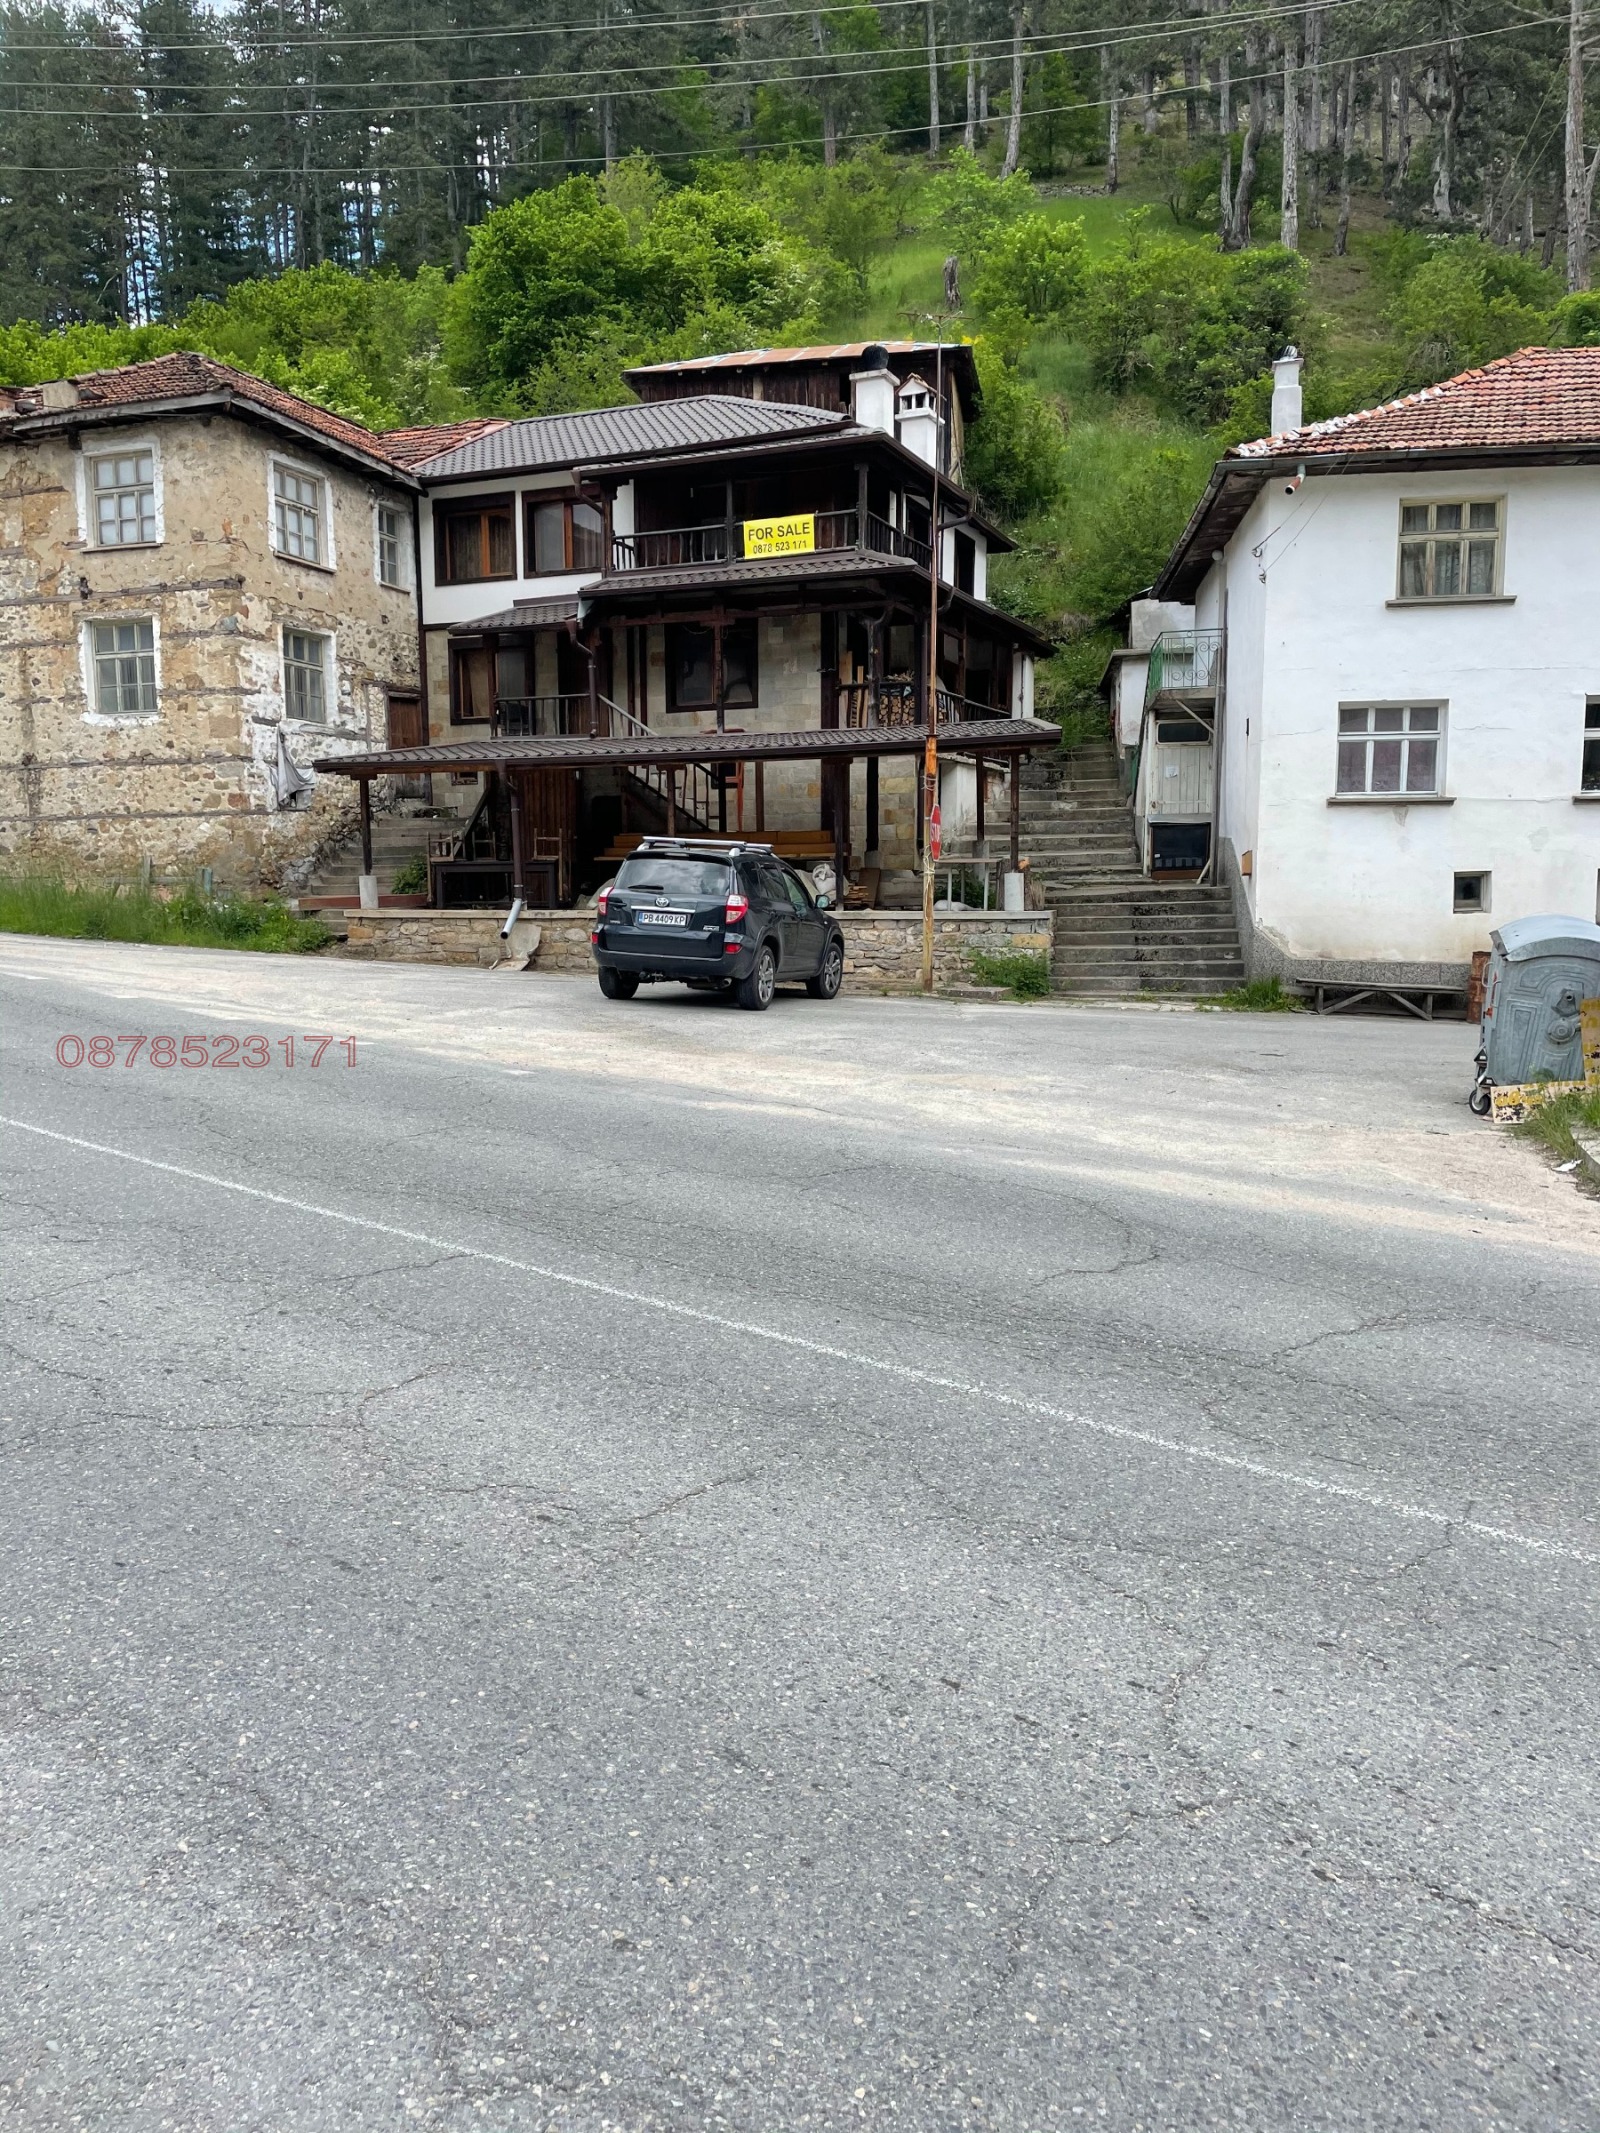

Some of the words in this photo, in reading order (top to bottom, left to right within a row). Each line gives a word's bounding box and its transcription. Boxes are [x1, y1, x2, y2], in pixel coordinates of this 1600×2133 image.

[748, 527, 773, 541] FOR
[777, 522, 810, 537] SALE
[753, 543, 772, 554] 0878
[775, 541, 790, 551] 523
[792, 540, 807, 549] 171
[643, 913, 654, 922] PB
[655, 914, 673, 923] 4409
[674, 915, 685, 924] KP
